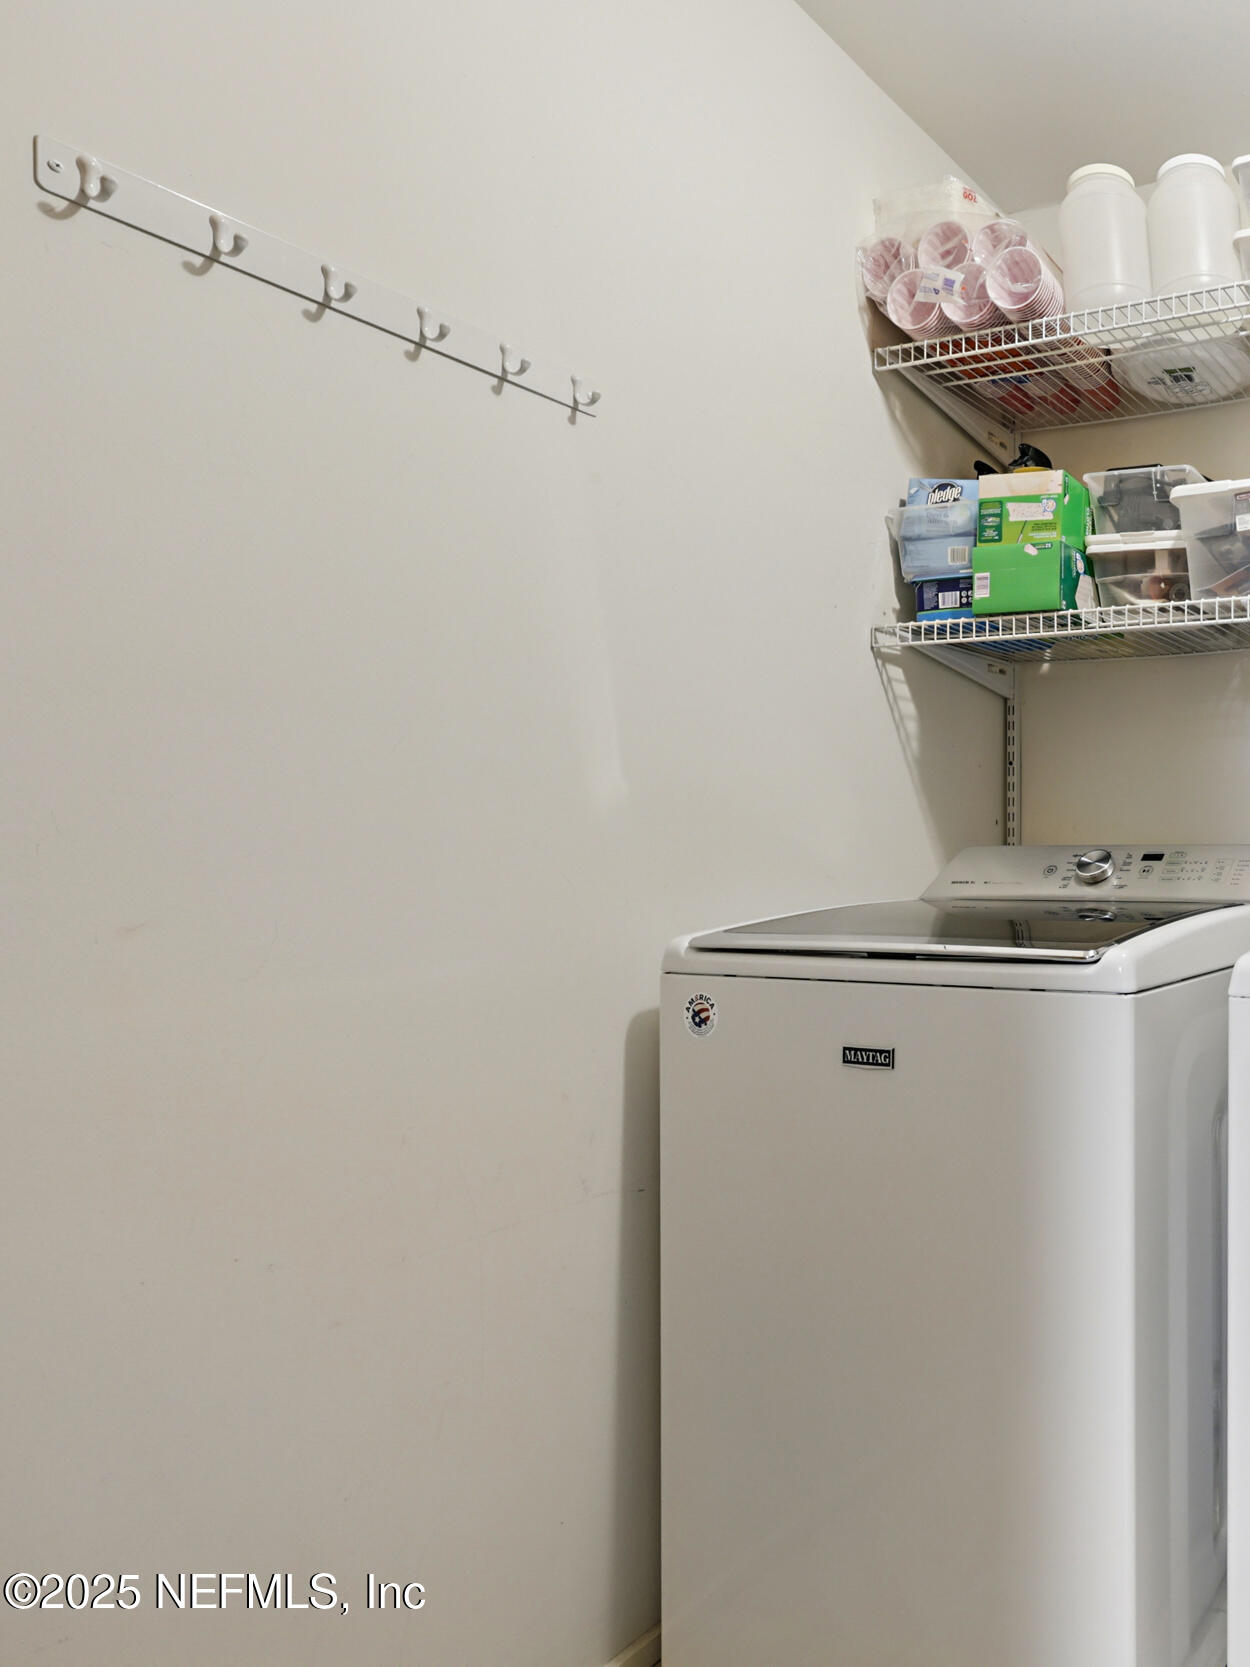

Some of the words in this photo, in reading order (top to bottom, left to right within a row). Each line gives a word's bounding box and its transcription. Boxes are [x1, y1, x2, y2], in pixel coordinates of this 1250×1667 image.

[927, 486, 962, 505] pledge
[685, 994, 715, 1013] AMERICA
[844, 1050, 891, 1065] MAYTAG
